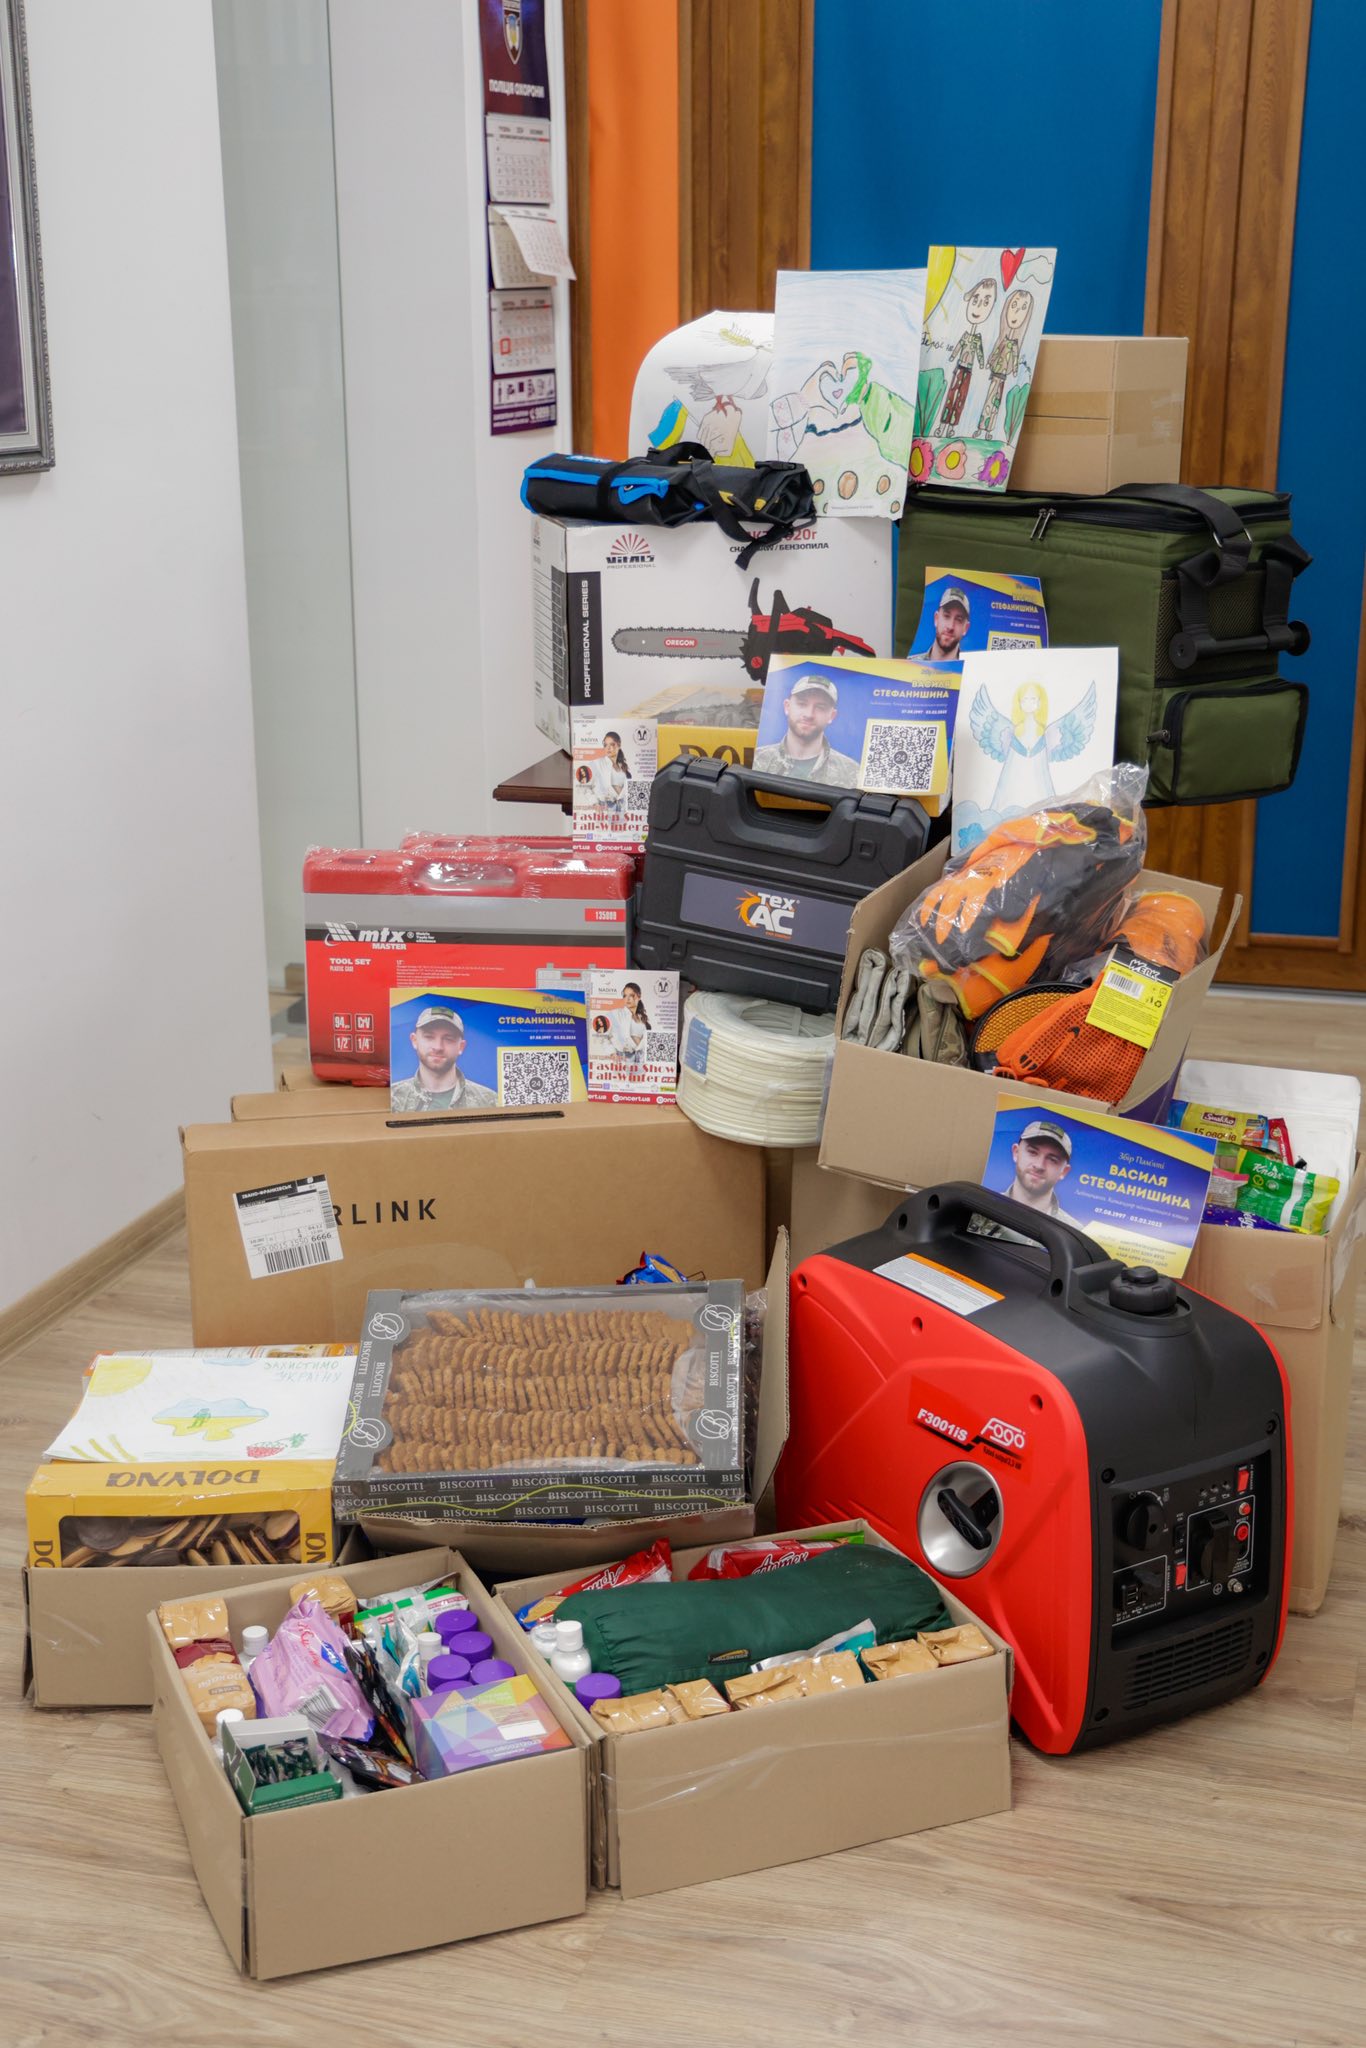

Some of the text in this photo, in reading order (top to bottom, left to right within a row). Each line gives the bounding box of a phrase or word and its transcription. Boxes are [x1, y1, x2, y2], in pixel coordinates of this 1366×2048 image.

[780, 542, 829, 551] БЕНЗОПИЛА
[581, 580, 589, 618] SERIES
[665, 639, 695, 647] OREGON
[873, 689, 949, 699] СТЕФАНИШИНА
[750, 905, 795, 935] AC
[358, 927, 406, 942] mtx
[498, 1016, 575, 1025] СТЕФАНИШИНА
[1109, 1164, 1168, 1187] ВАСИЛЯ
[1079, 1174, 1191, 1210] СТЕФАНИШИНА
[311, 1232, 332, 1242] 6666
[358, 1341, 372, 1375] BISCOTTI
[709, 1352, 720, 1386] BISCOTTI
[371, 1362, 386, 1397] BISCOTTI
[917, 1408, 968, 1441] F3001iS
[370, 1482, 424, 1493] BISCOTTI
[439, 1479, 494, 1490] BISCOTTI
[512, 1477, 566, 1487] BISCOTTI
[582, 1475, 636, 1485] BISCOTTI
[652, 1474, 706, 1483] BISCOTTI
[476, 1493, 530, 1502] BISCOTTI
[548, 1491, 602, 1500] BISCOTTI
[619, 1489, 671, 1498] BISCOTTI
[688, 1488, 741, 1497] BISCOTTI
[443, 1508, 497, 1517] BISCOTTI
[515, 1506, 569, 1516] BISCOTTI
[585, 1503, 638, 1513] BISCOTTI
[655, 1502, 708, 1511] BISCOTTI
